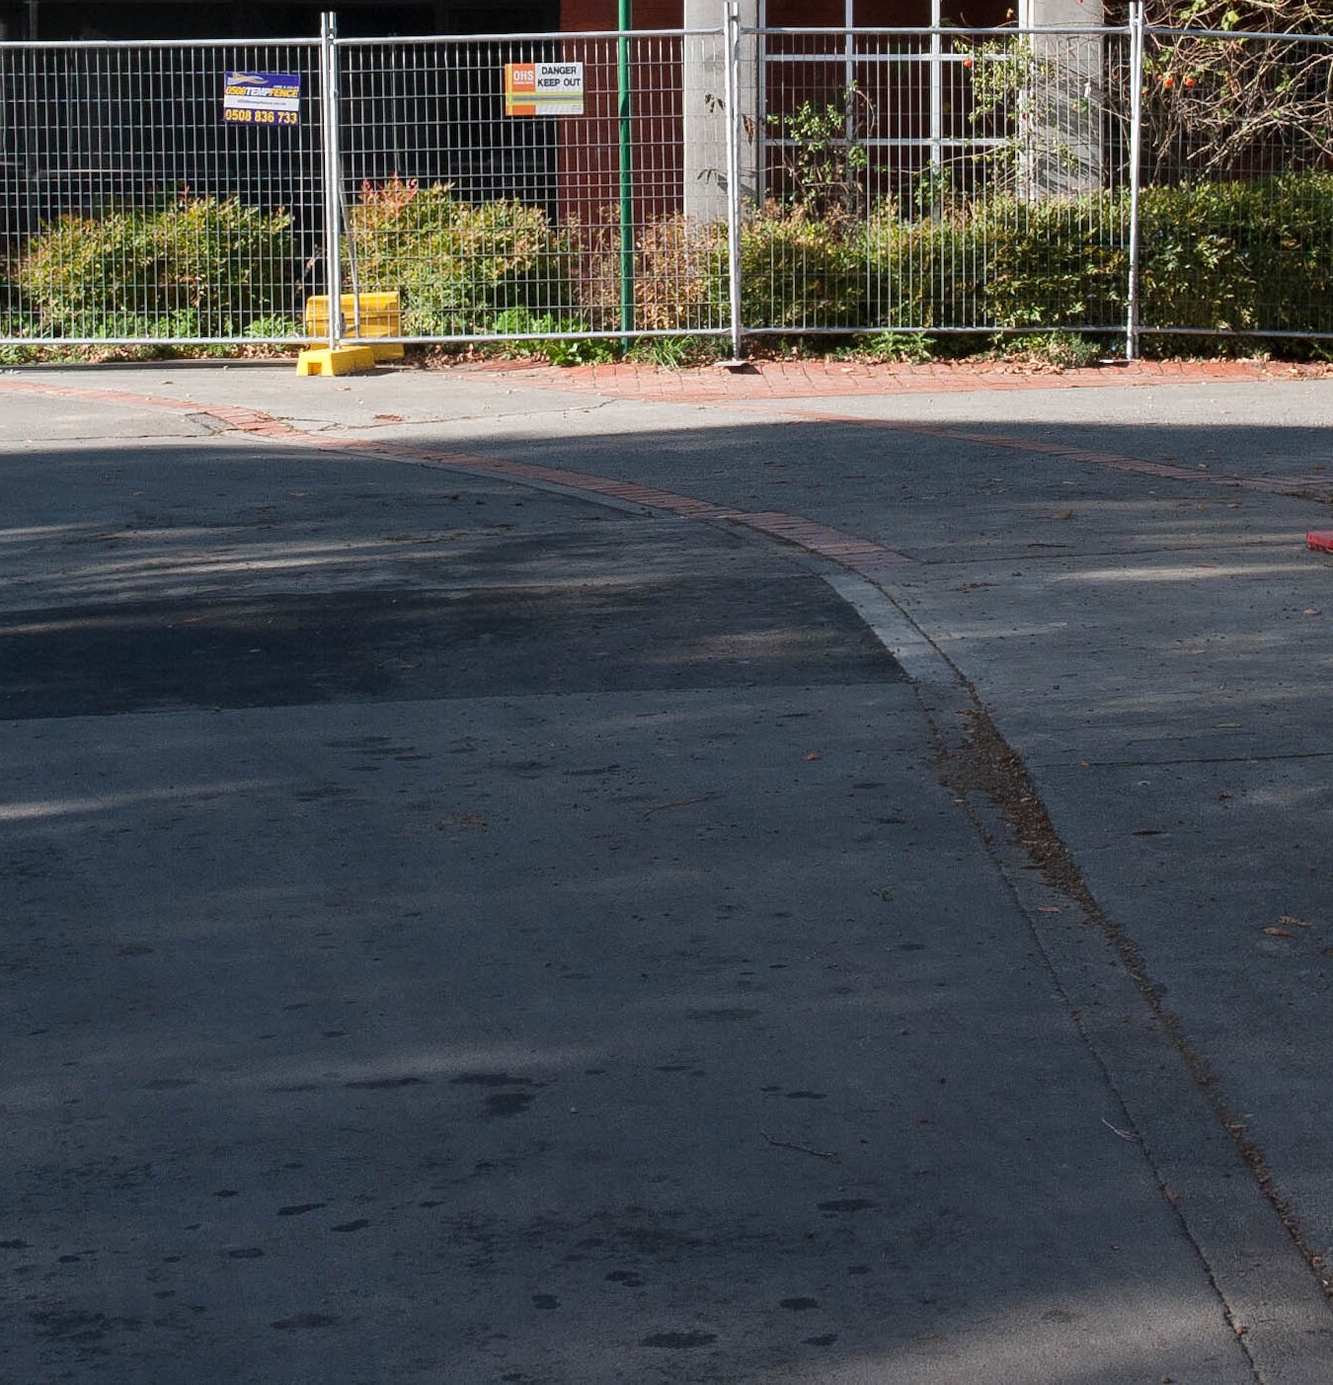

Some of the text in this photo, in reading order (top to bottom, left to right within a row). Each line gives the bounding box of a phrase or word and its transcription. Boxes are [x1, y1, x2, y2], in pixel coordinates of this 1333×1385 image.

[513, 70, 534, 81] OHS
[541, 66, 577, 75] DANGER
[537, 79, 560, 87] KEEP
[563, 78, 581, 86] OUT
[225, 108, 298, 124] 0508 836 733
